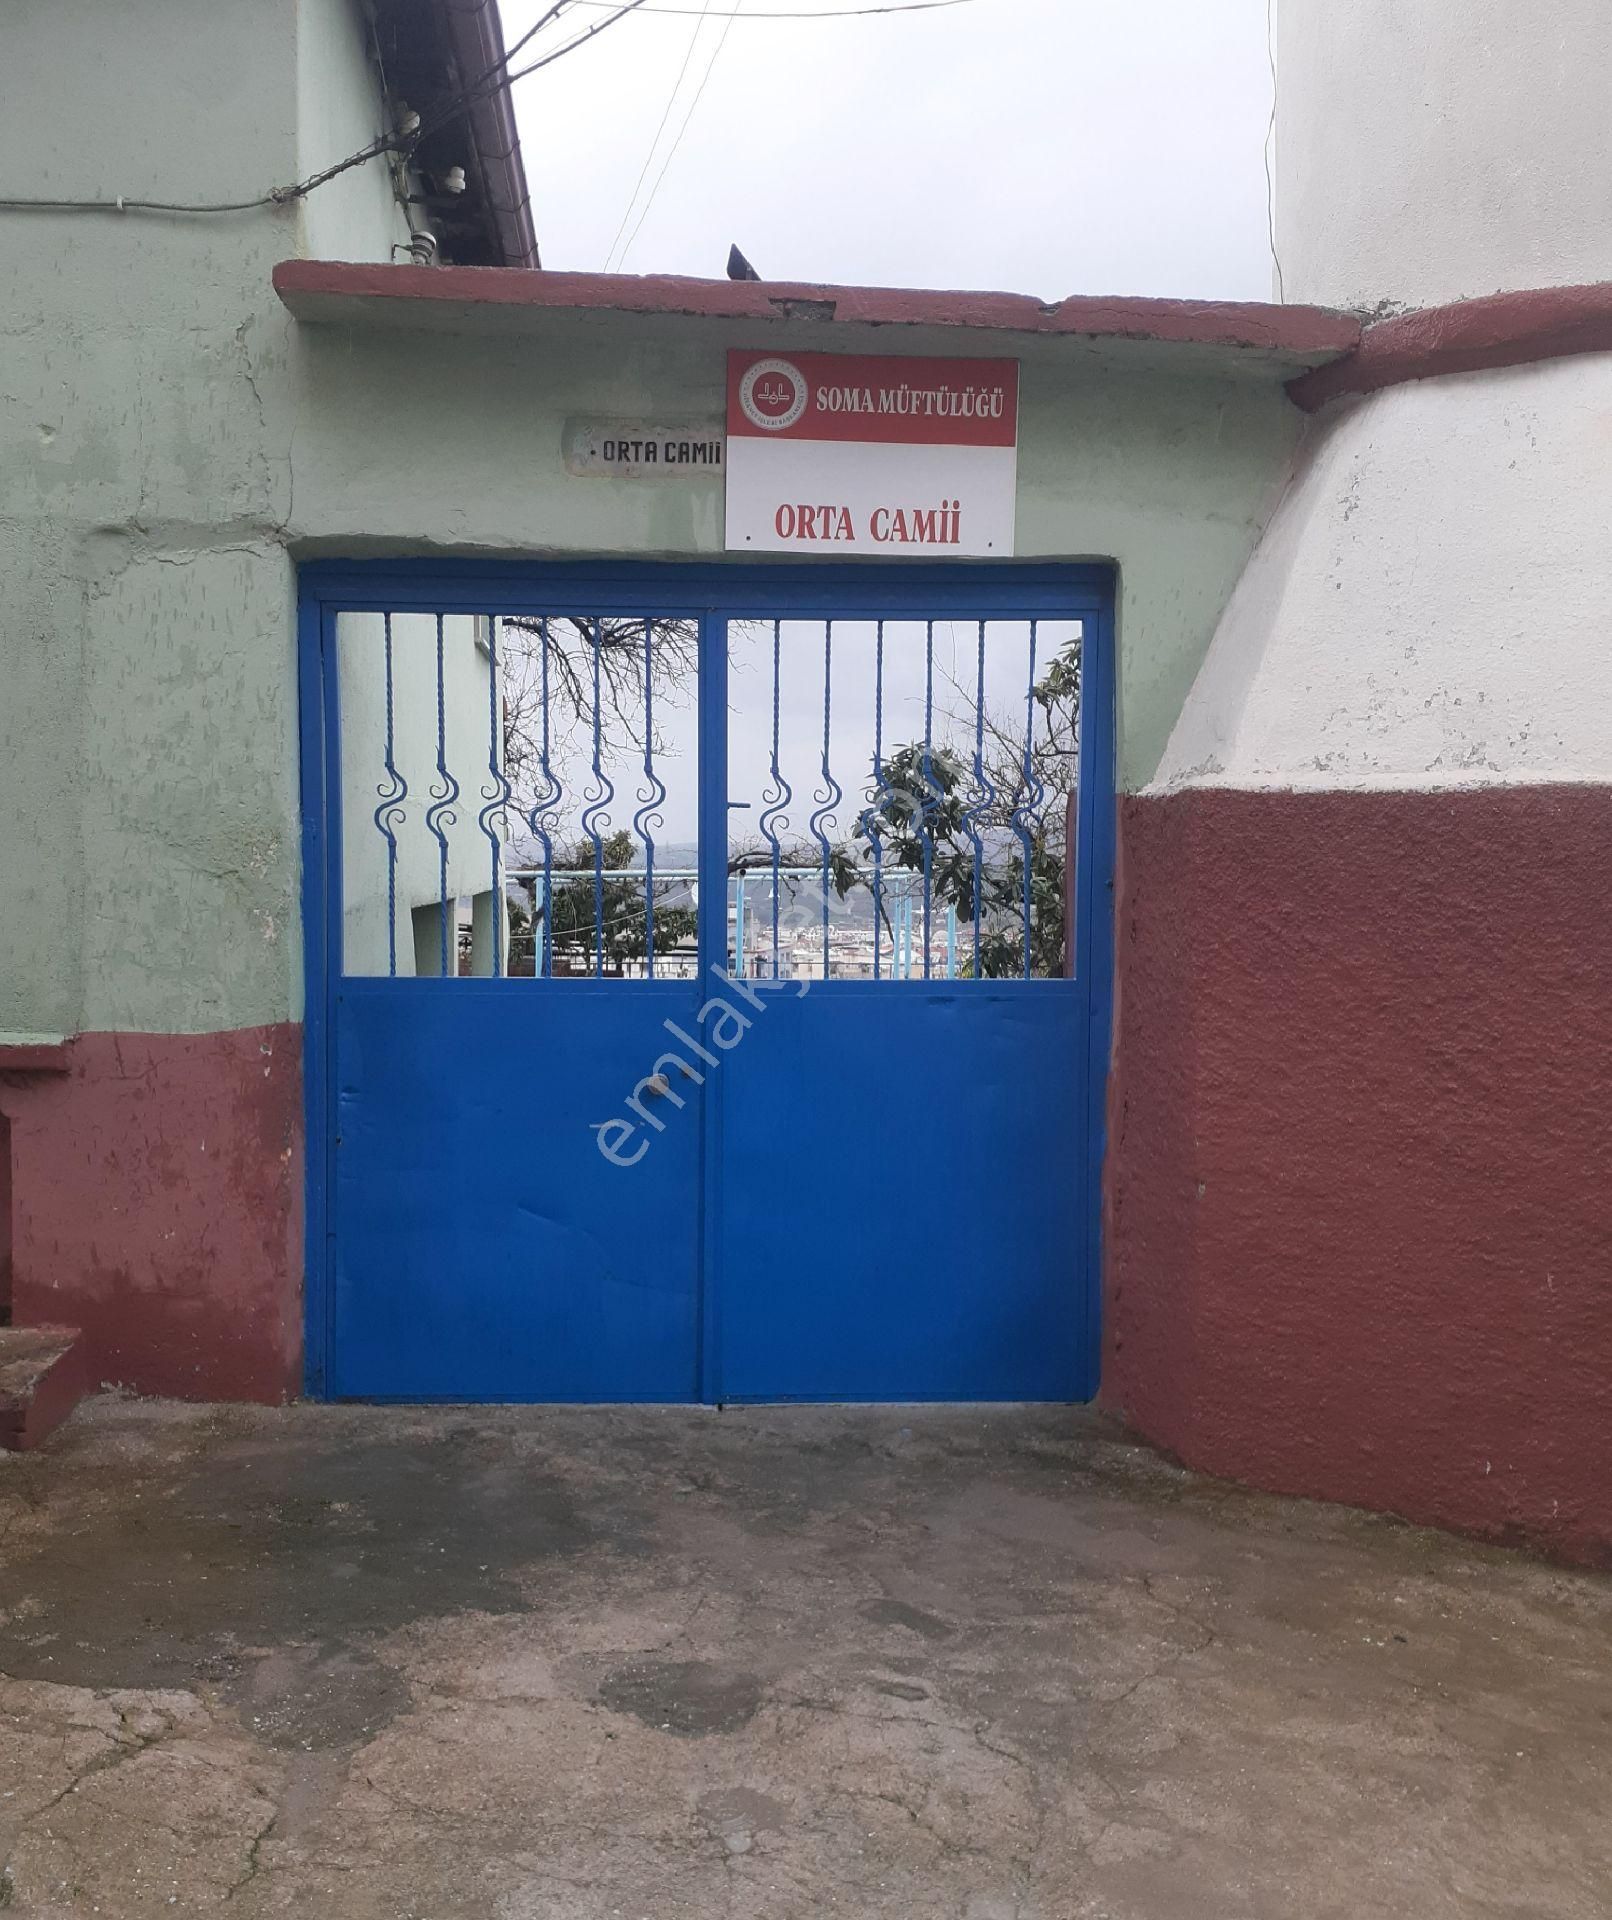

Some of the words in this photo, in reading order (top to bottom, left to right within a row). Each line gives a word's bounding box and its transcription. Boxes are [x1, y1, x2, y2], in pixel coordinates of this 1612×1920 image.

[816, 386, 875, 413] SOMA
[877, 384, 1005, 418] MÜFTÜLÜĞÜ
[603, 440, 658, 462] ORTA
[775, 503, 856, 541] ORTA
